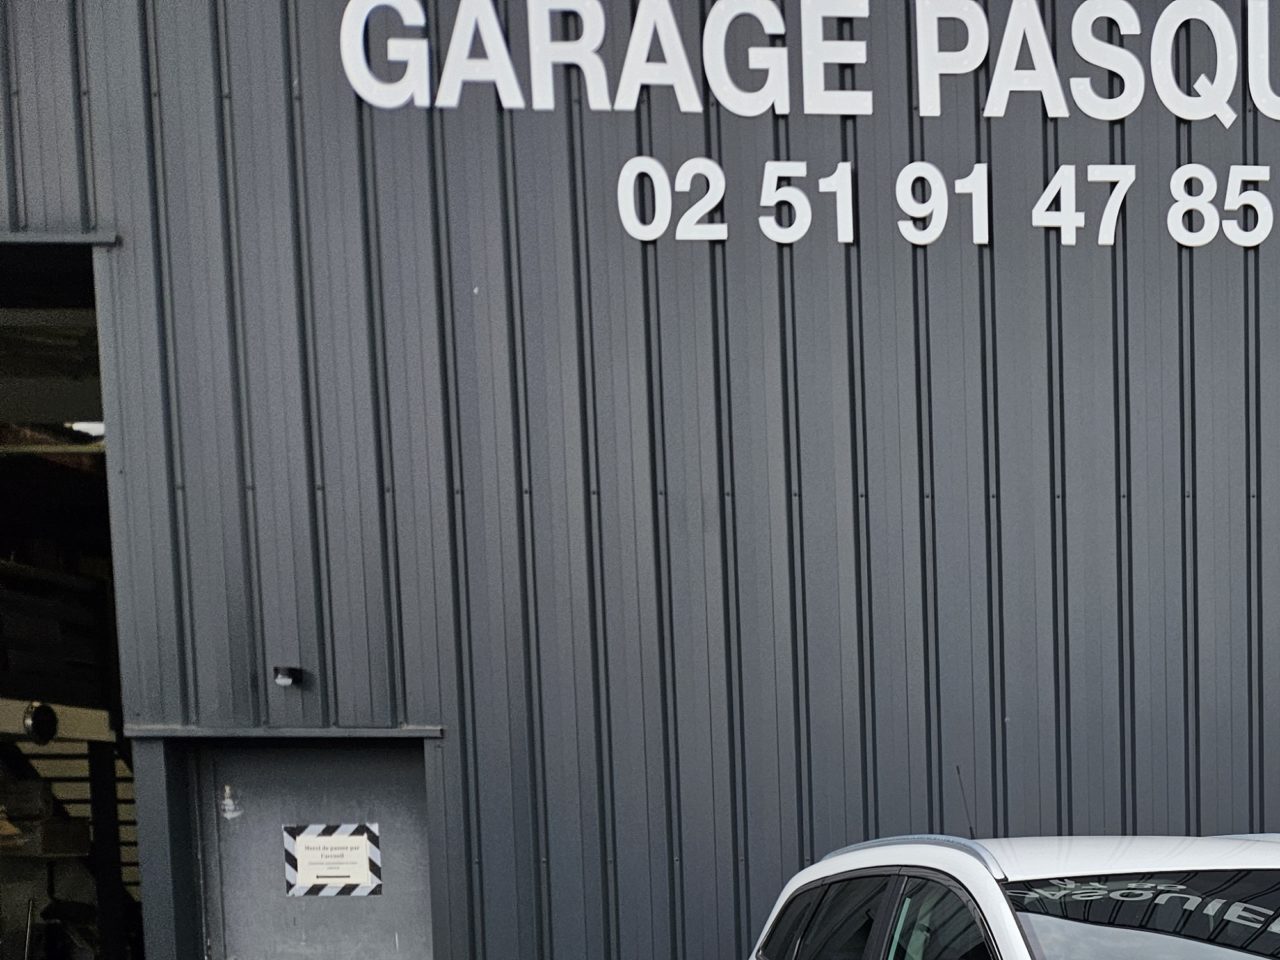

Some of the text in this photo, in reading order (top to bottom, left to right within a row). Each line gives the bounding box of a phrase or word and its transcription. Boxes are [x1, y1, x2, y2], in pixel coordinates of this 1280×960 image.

[340, 0, 873, 117] GARAGE
[617, 156, 1274, 248] 02 51 91 47 85
